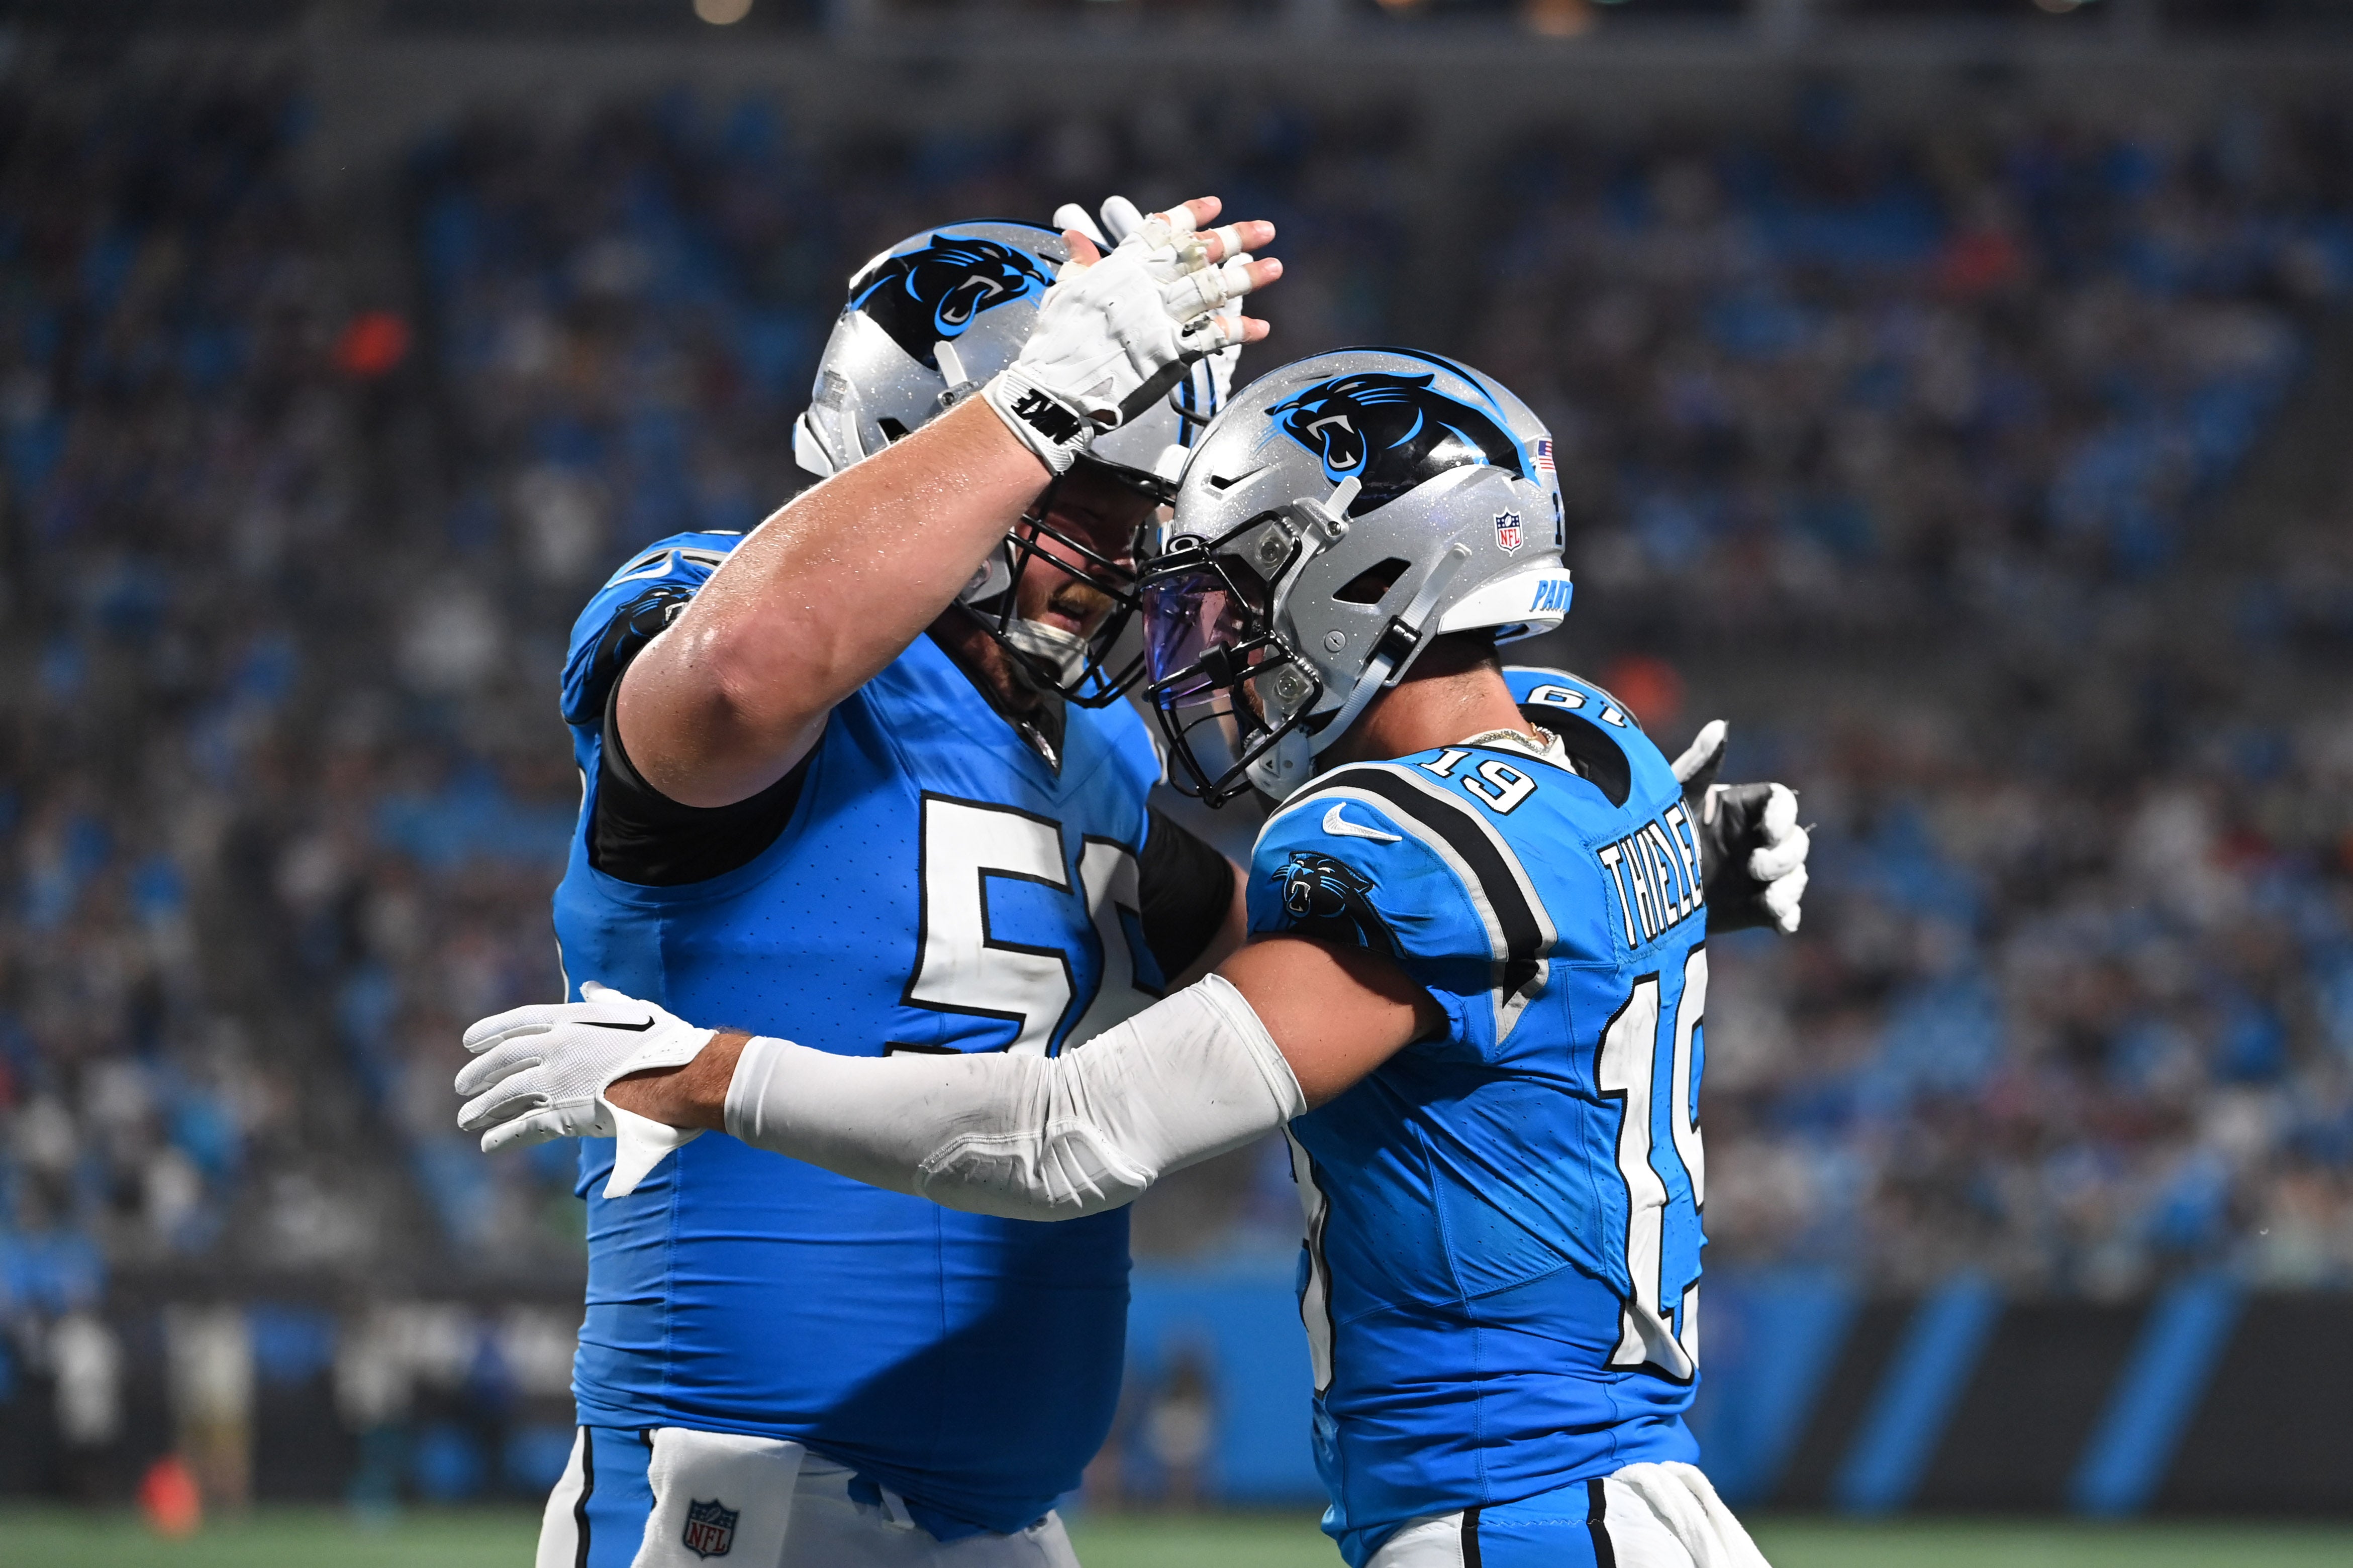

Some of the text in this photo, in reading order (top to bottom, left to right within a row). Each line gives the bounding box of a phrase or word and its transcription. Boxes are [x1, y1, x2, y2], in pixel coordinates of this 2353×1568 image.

[1011, 388, 1083, 445] NIKE
[1500, 528, 1520, 547] NFL
[1416, 748, 1538, 816] 19
[688, 1522, 726, 1552] NFL
